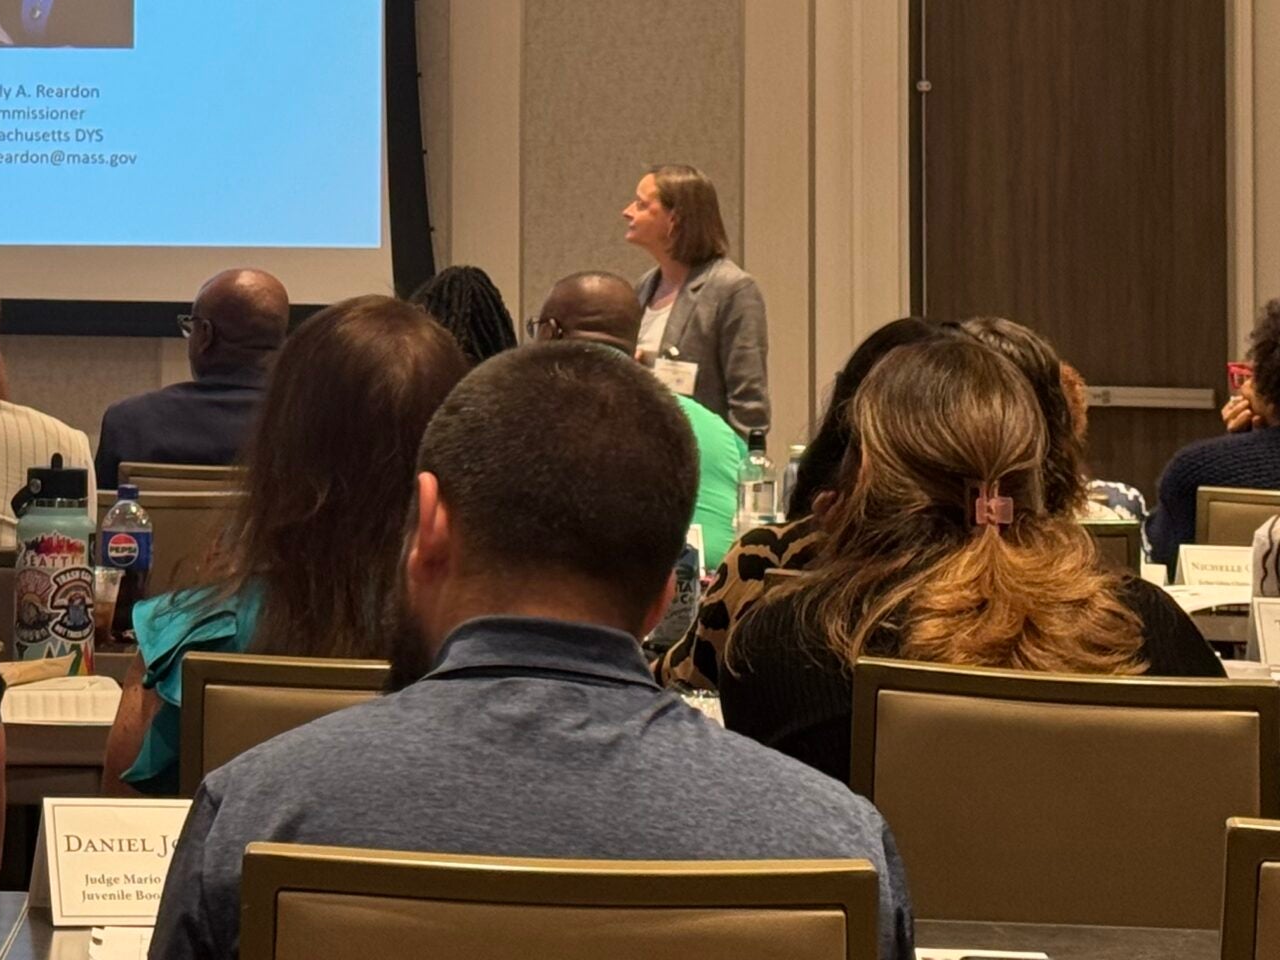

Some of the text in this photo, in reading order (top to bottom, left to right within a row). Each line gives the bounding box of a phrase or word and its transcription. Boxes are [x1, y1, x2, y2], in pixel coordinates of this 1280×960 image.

[15, 84, 31, 98] A.
[36, 84, 100, 98] Reardon
[75, 128, 104, 142] DYS
[109, 545, 137, 554] PEPSI
[63, 834, 155, 853] DANIEL
[84, 873, 161, 887] Judge Mario
[81, 889, 132, 903] Juvenile
